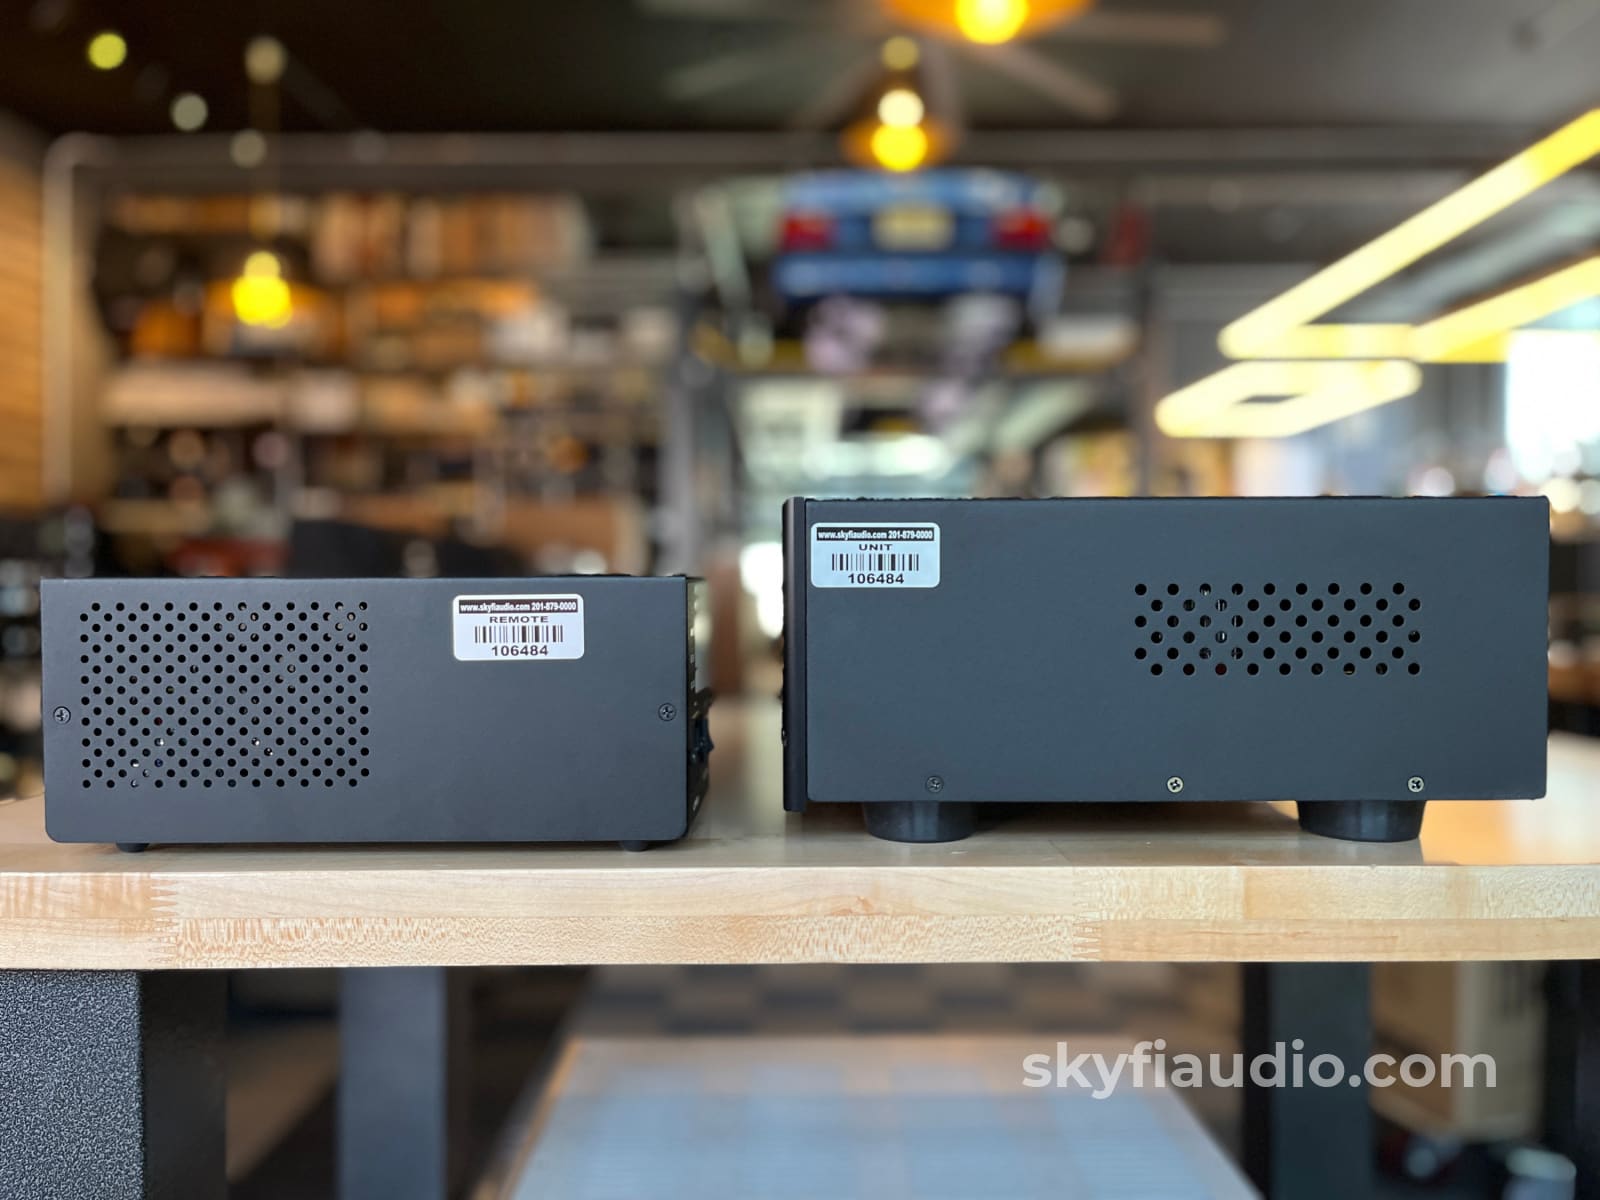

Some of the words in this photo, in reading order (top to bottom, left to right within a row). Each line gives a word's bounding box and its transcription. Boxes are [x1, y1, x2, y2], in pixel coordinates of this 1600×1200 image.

[818, 530, 887, 540] www.skyfiaudio.com
[858, 543, 893, 551] UNIT
[848, 573, 905, 584] 106484
[460, 602, 530, 613] www.skyfiaudio.com
[489, 615, 549, 624] REMOTE
[491, 645, 549, 656] 106484
